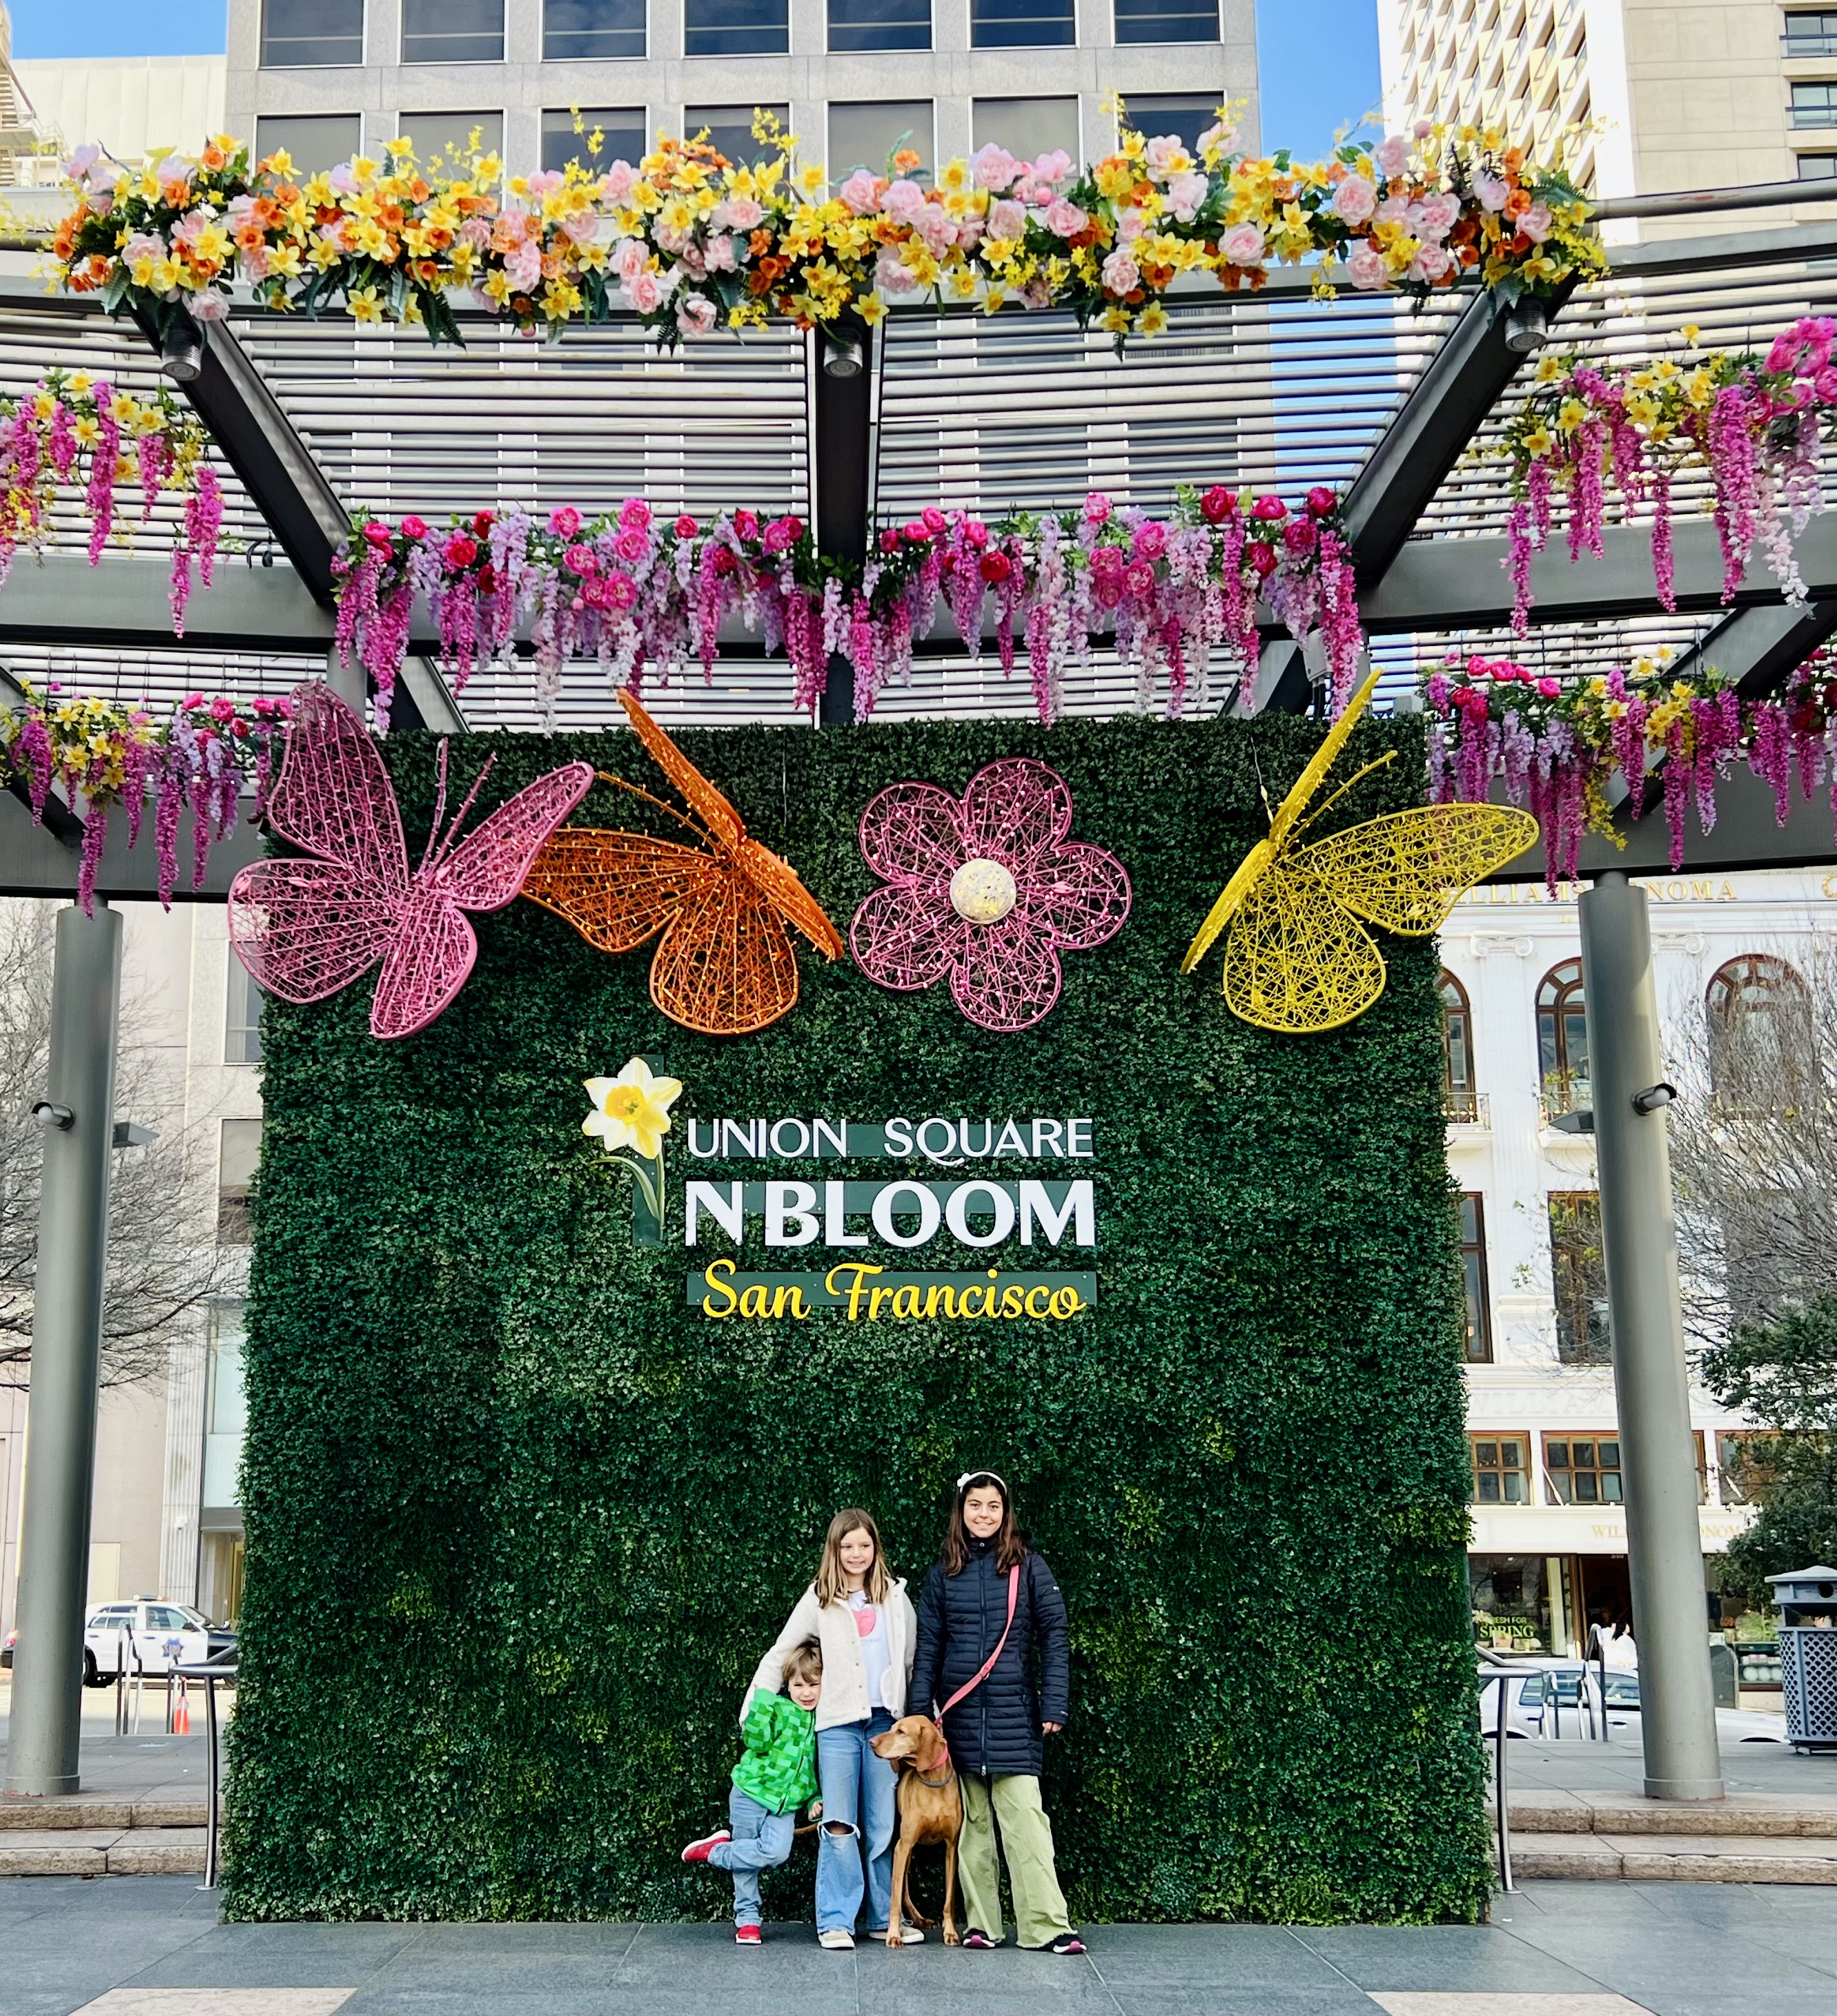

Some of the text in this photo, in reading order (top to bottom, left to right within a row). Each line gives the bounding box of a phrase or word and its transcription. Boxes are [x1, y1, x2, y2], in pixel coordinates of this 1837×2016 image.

[687, 1117, 1094, 1166] UNION SQUARE
[685, 1180, 1096, 1248] N BLOOM
[703, 1259, 1087, 1322] San Francisco
[1480, 1625, 1534, 1638] SPRING
